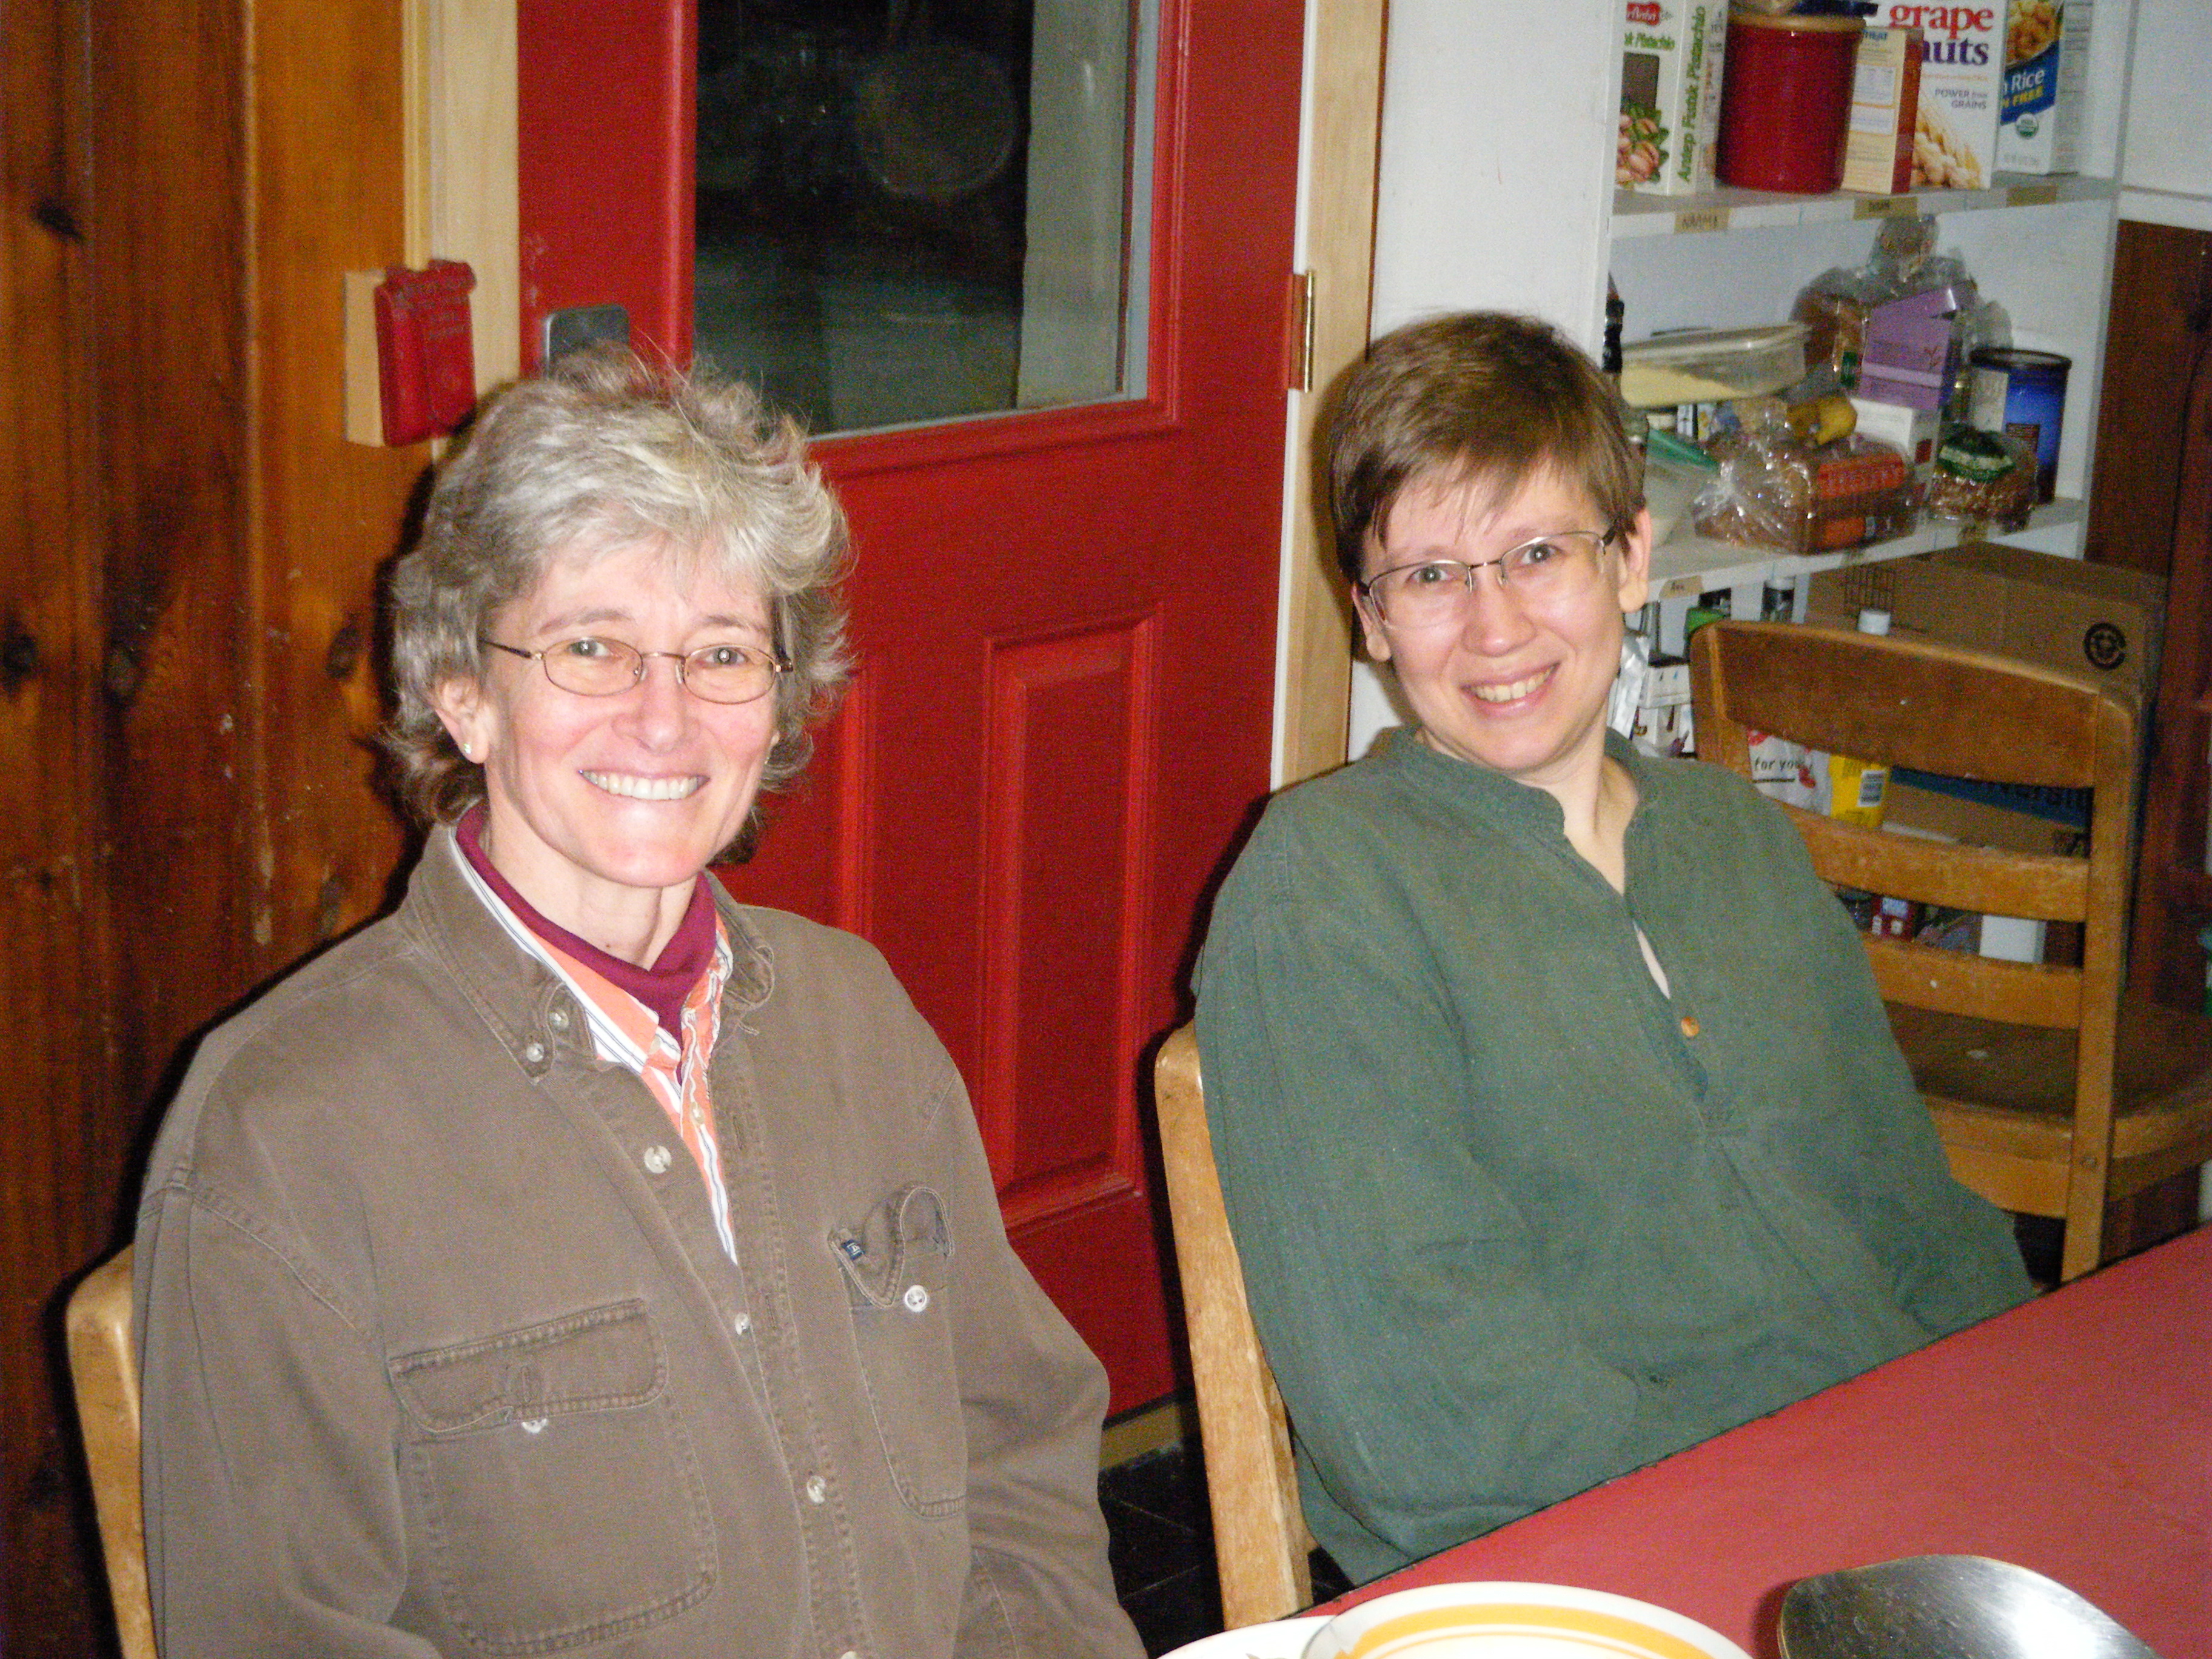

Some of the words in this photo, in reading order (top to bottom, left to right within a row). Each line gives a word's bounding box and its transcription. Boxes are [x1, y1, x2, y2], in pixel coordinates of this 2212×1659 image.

[1889, 5, 1994, 40] grape
[2011, 69, 2045, 92] Rice
[1935, 89, 1970, 99] POWER
[1951, 99, 1986, 110] GRAINS
